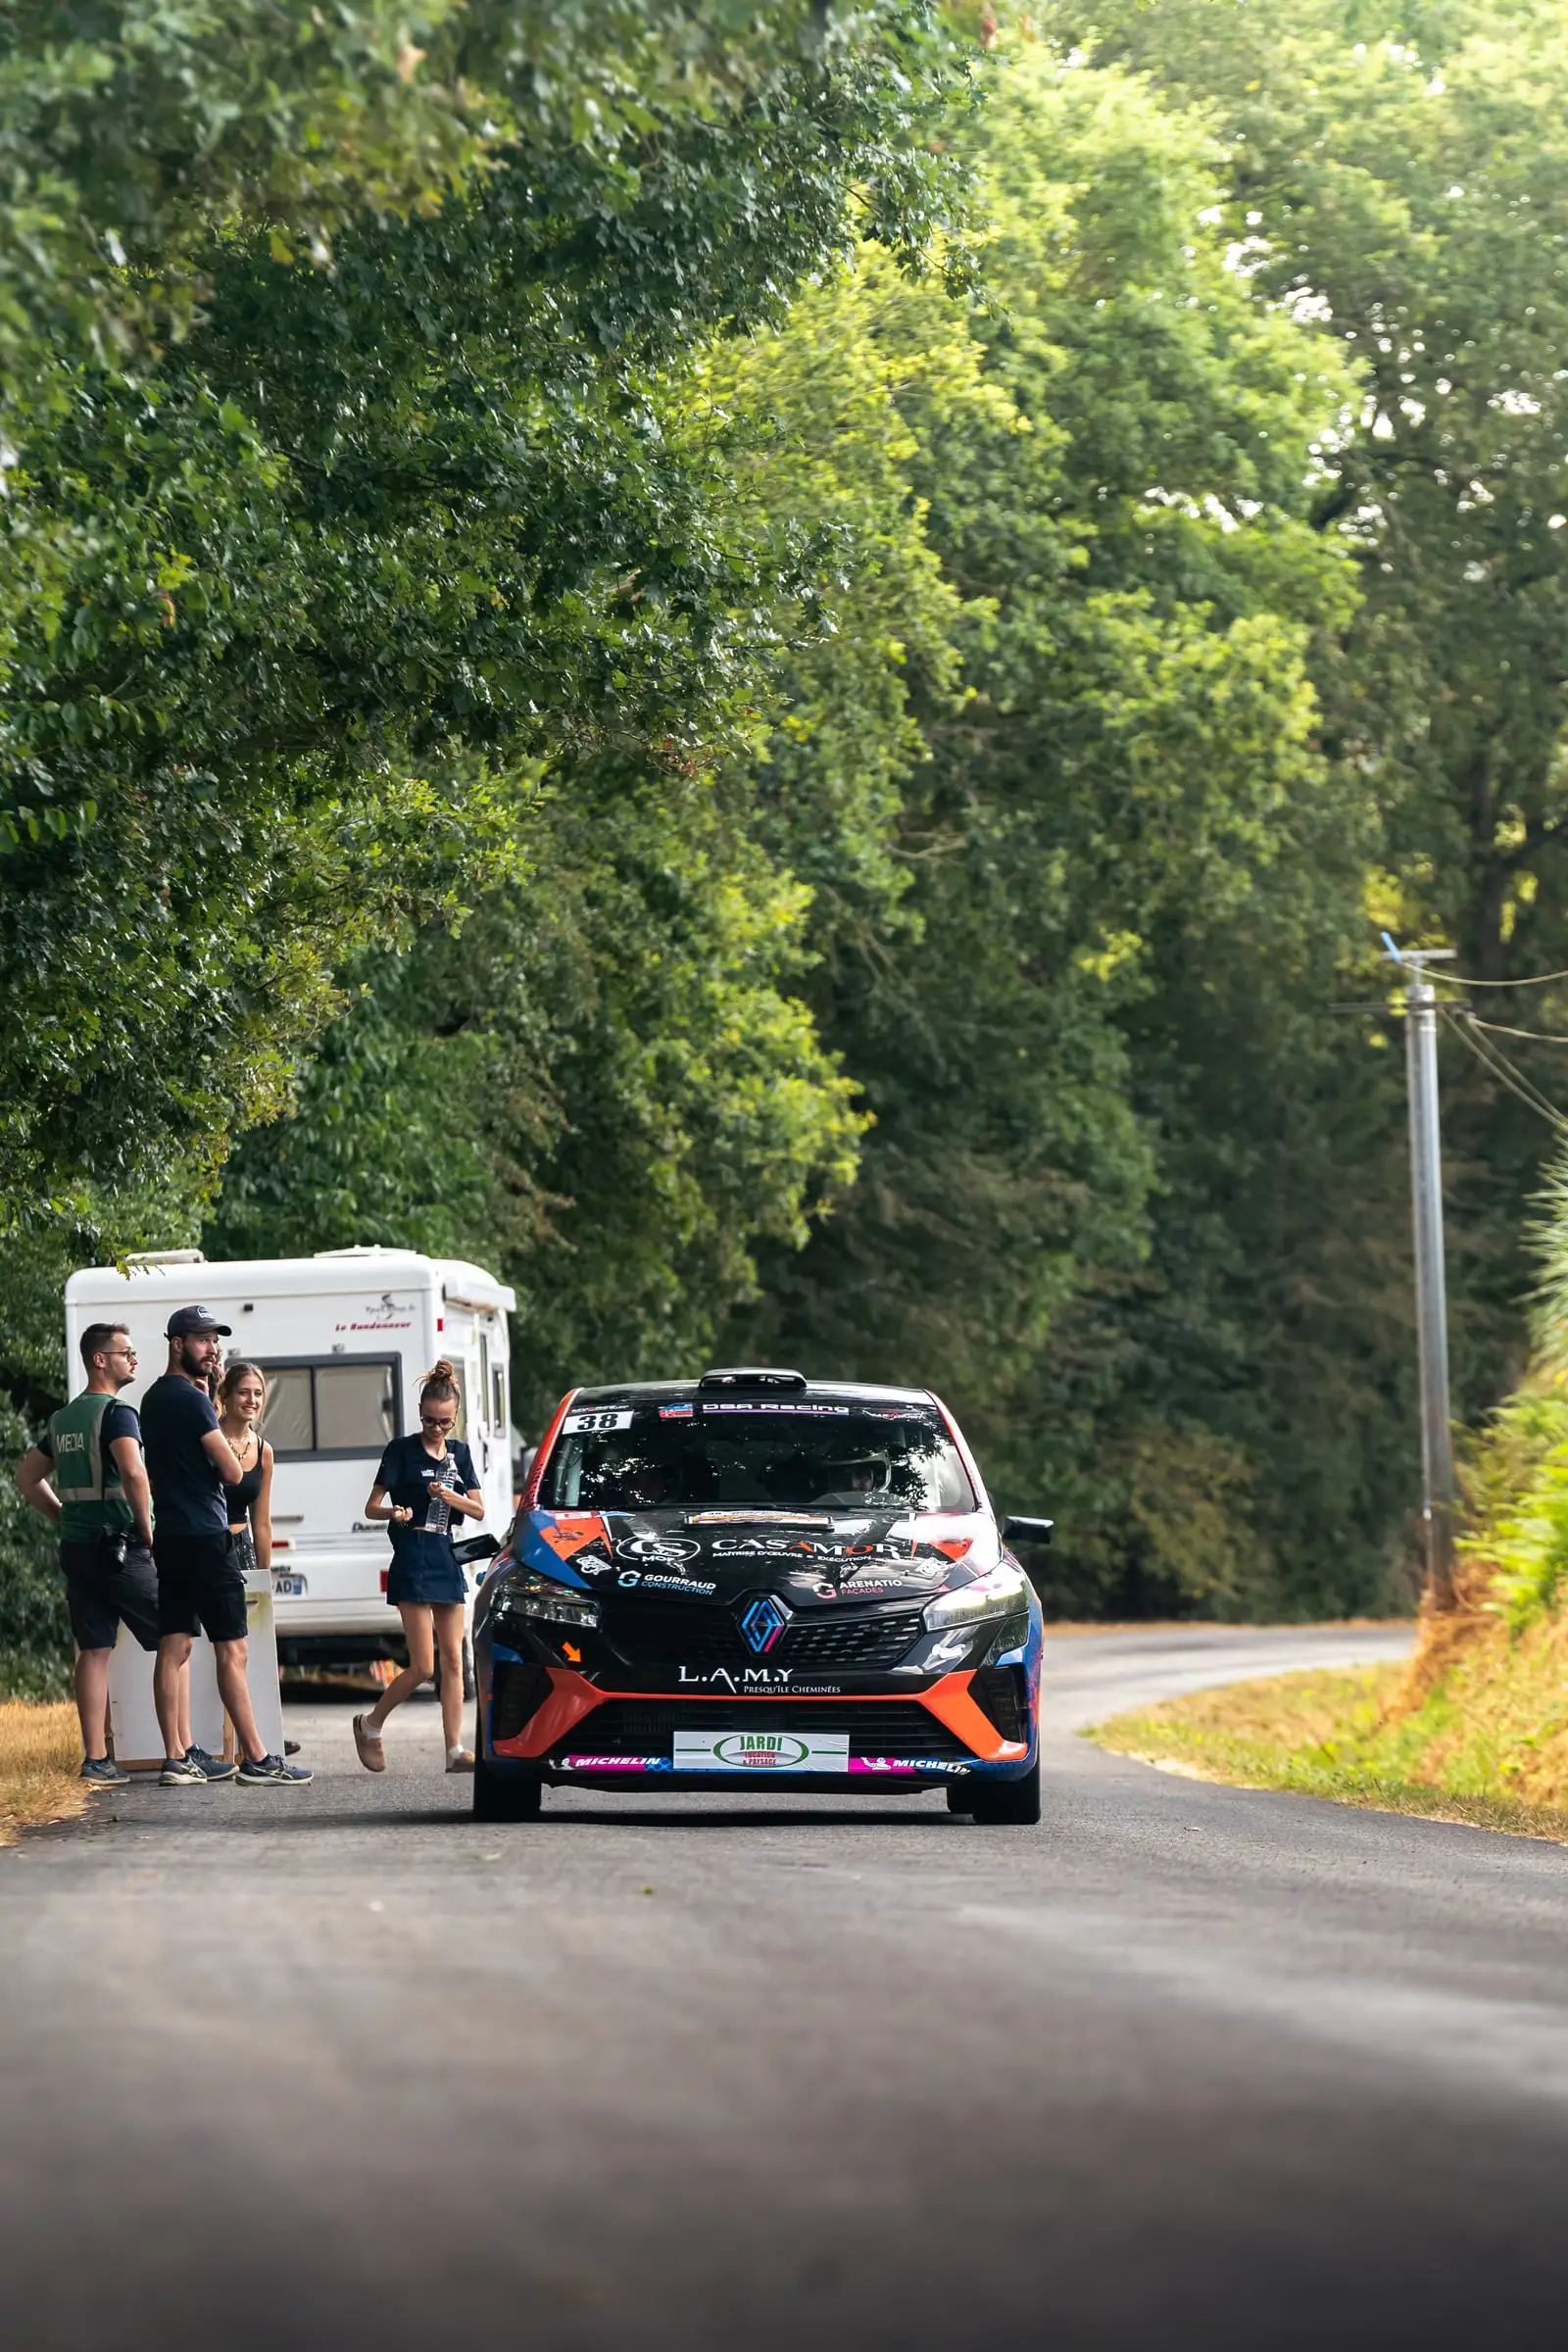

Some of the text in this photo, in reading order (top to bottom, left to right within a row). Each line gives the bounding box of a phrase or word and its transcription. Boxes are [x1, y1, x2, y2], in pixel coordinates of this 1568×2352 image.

[760, 1403, 850, 1414] Racing
[577, 1413, 618, 1431] 38
[710, 1539, 901, 1560] CASAMOR
[641, 1581, 713, 1595] CONSTRUCTION
[644, 1574, 716, 1590] GOURRAUD
[840, 1579, 903, 1590] ARENATIO
[740, 1736, 783, 1751] JARDI
[575, 1757, 662, 1767] MICHELIN
[893, 1759, 971, 1776] MICHELIN
